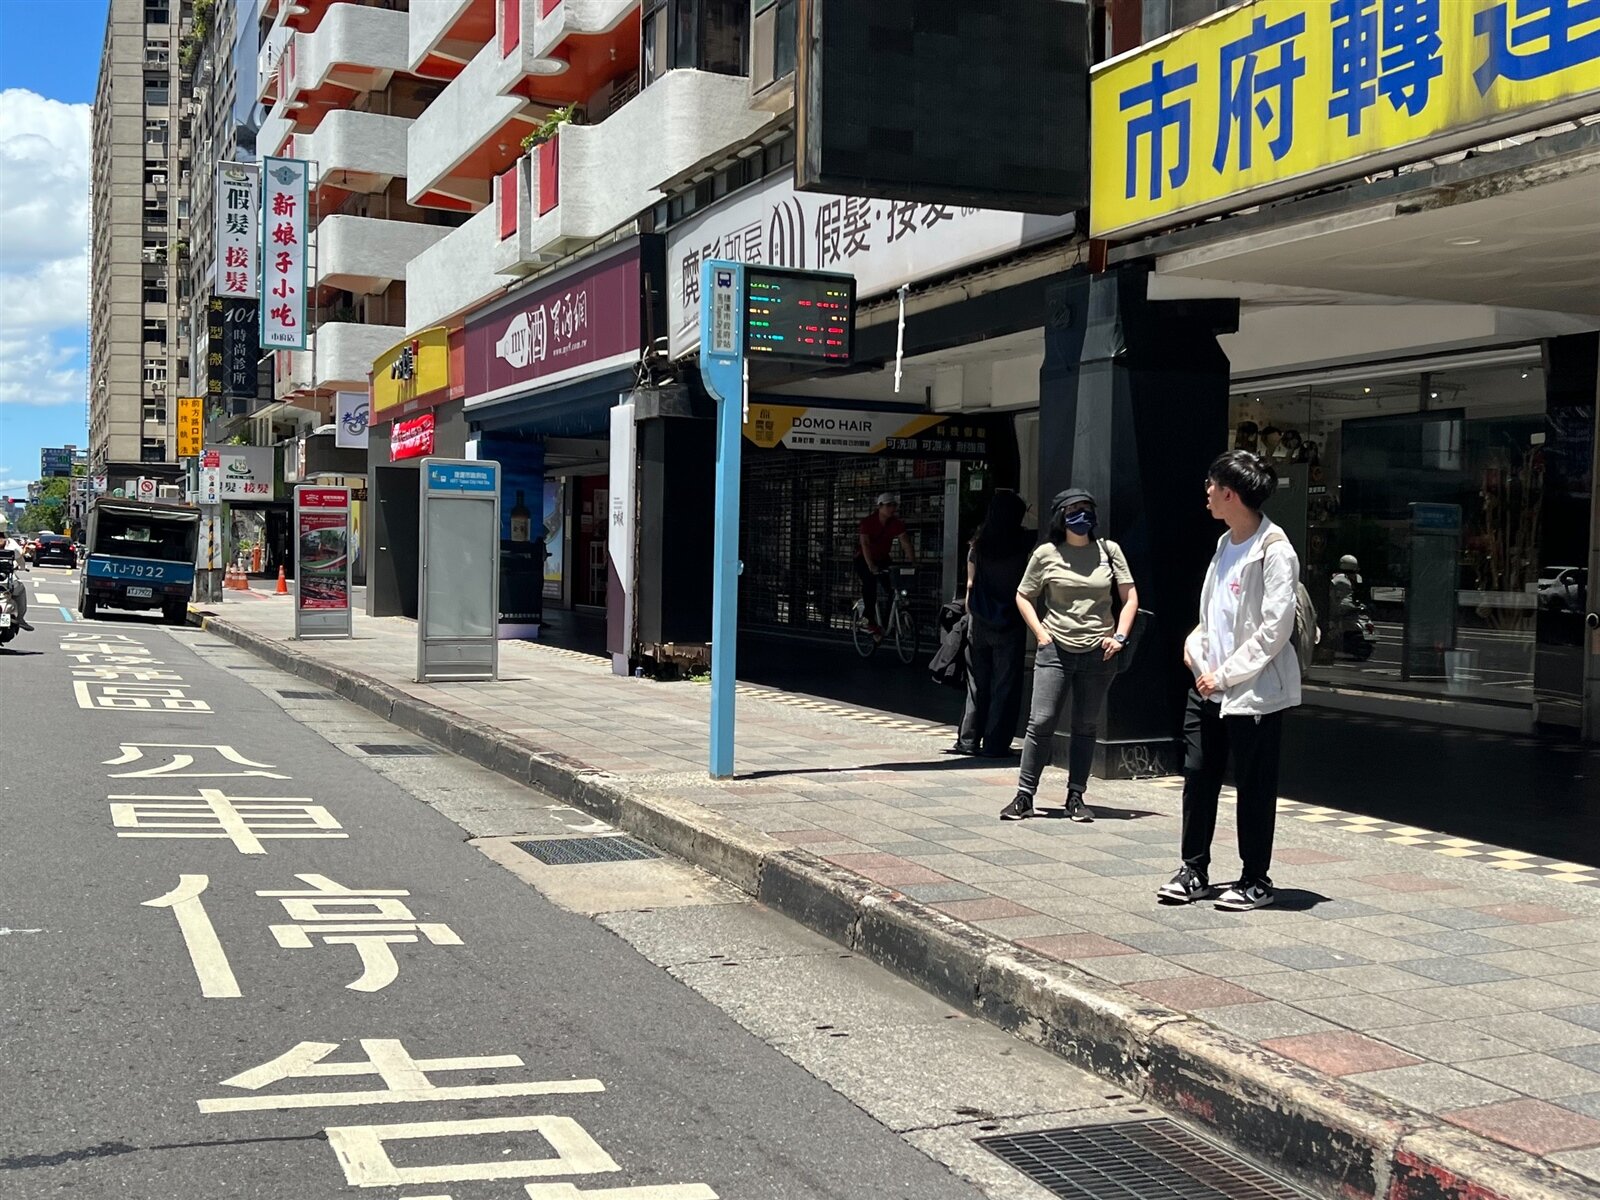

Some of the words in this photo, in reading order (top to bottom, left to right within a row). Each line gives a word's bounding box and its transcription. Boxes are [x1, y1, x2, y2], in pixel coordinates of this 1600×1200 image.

[271, 192, 297, 327] 新娘子小吃
[225, 308, 255, 323] 101
[792, 417, 836, 430] DOMO
[839, 420, 872, 432] HAIR
[102, 563, 164, 578] ATJ-7922
